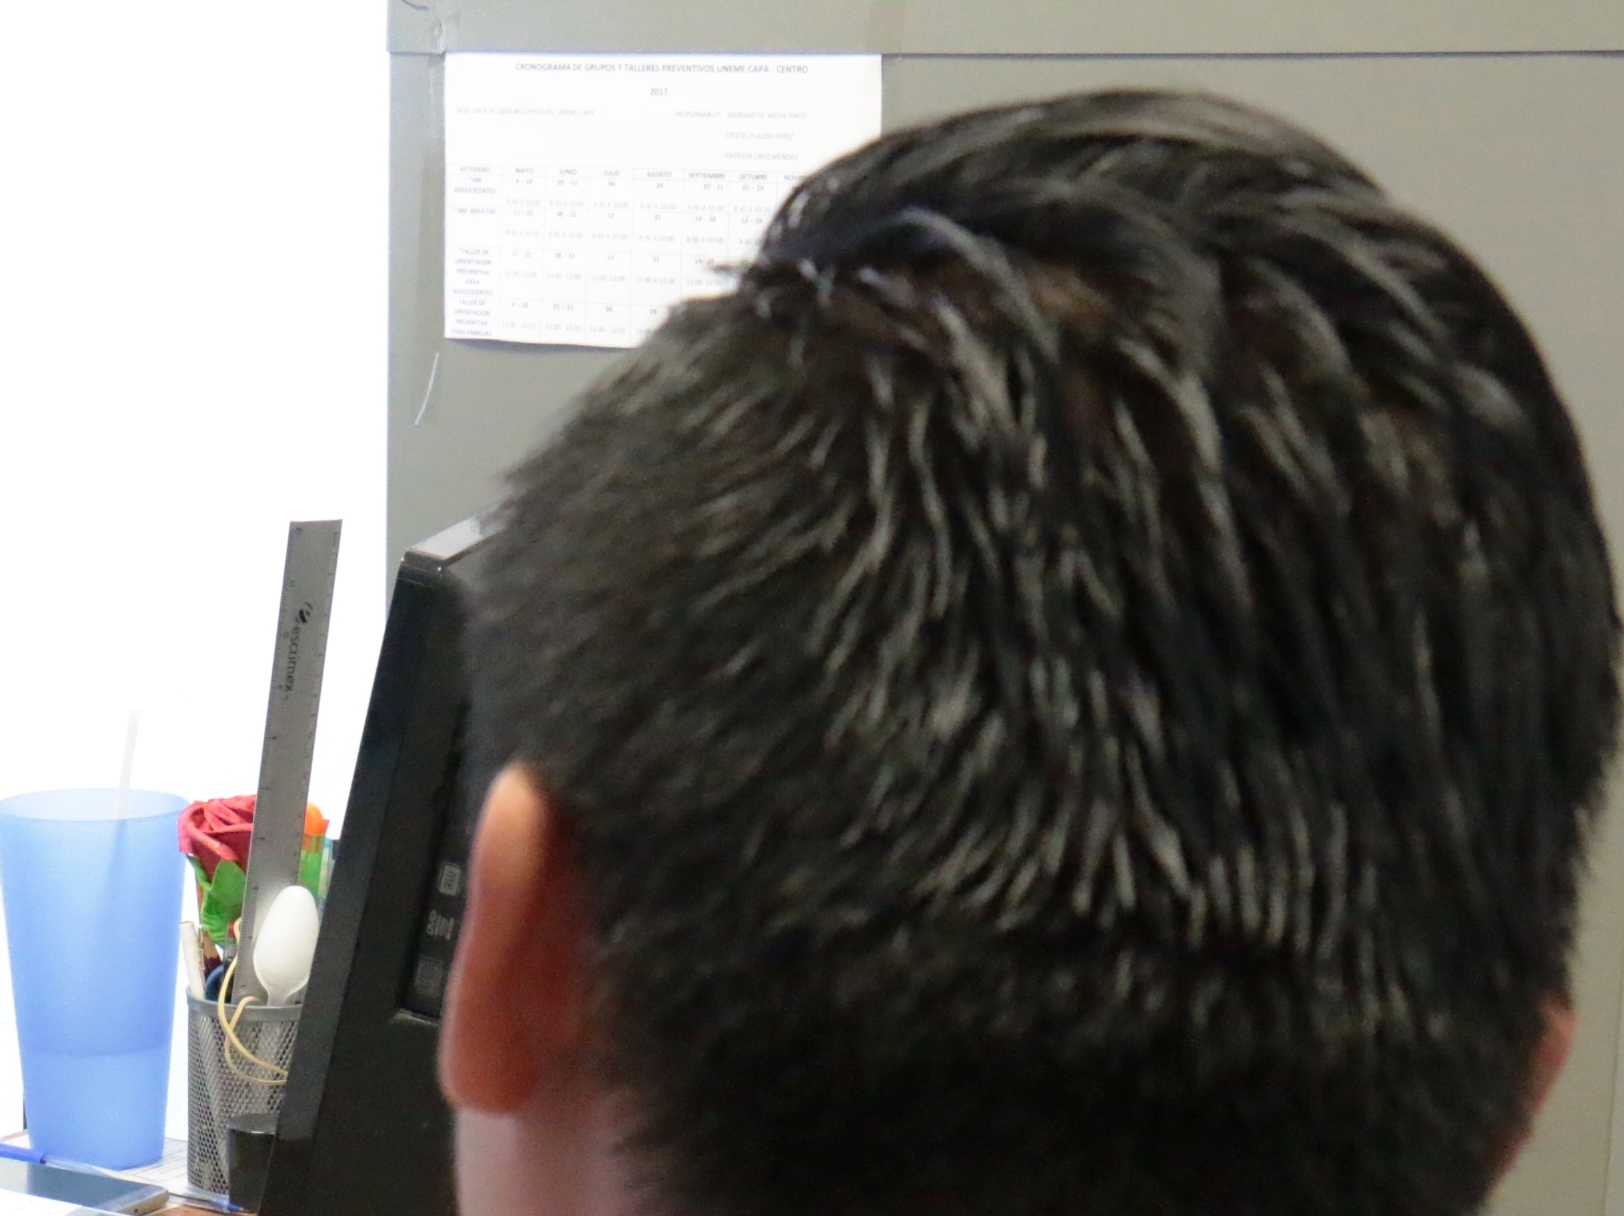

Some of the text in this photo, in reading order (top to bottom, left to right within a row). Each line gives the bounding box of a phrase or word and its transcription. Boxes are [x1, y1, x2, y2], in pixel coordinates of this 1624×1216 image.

[624, 64, 659, 72] TALLERES
[662, 65, 715, 73] PREVENTIVOS
[717, 65, 745, 73] UNEME
[748, 65, 769, 73] CAPA
[650, 88, 668, 96] 2017
[284, 626, 301, 692] escrimex
